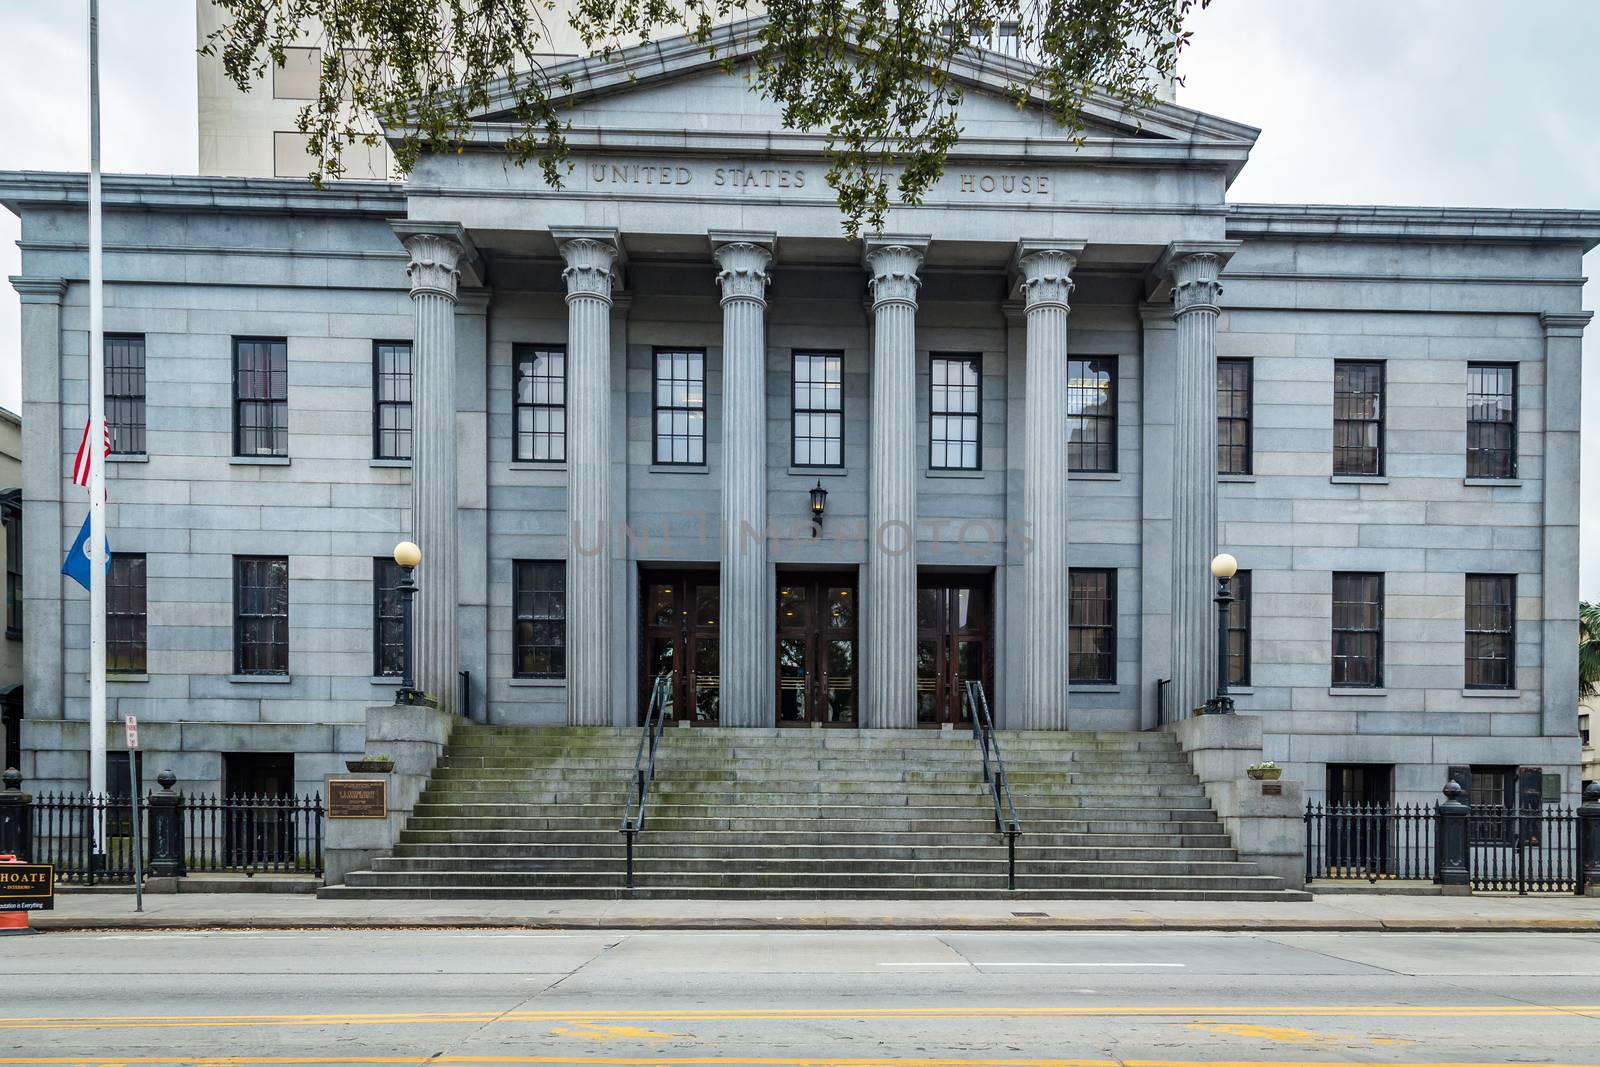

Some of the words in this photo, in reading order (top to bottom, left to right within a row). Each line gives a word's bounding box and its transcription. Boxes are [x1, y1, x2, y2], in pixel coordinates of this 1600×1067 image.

[591, 164, 693, 185] UNITED
[714, 167, 806, 188] STATES
[960, 174, 1049, 194] HOUSE
[0, 873, 46, 882] HOATE
